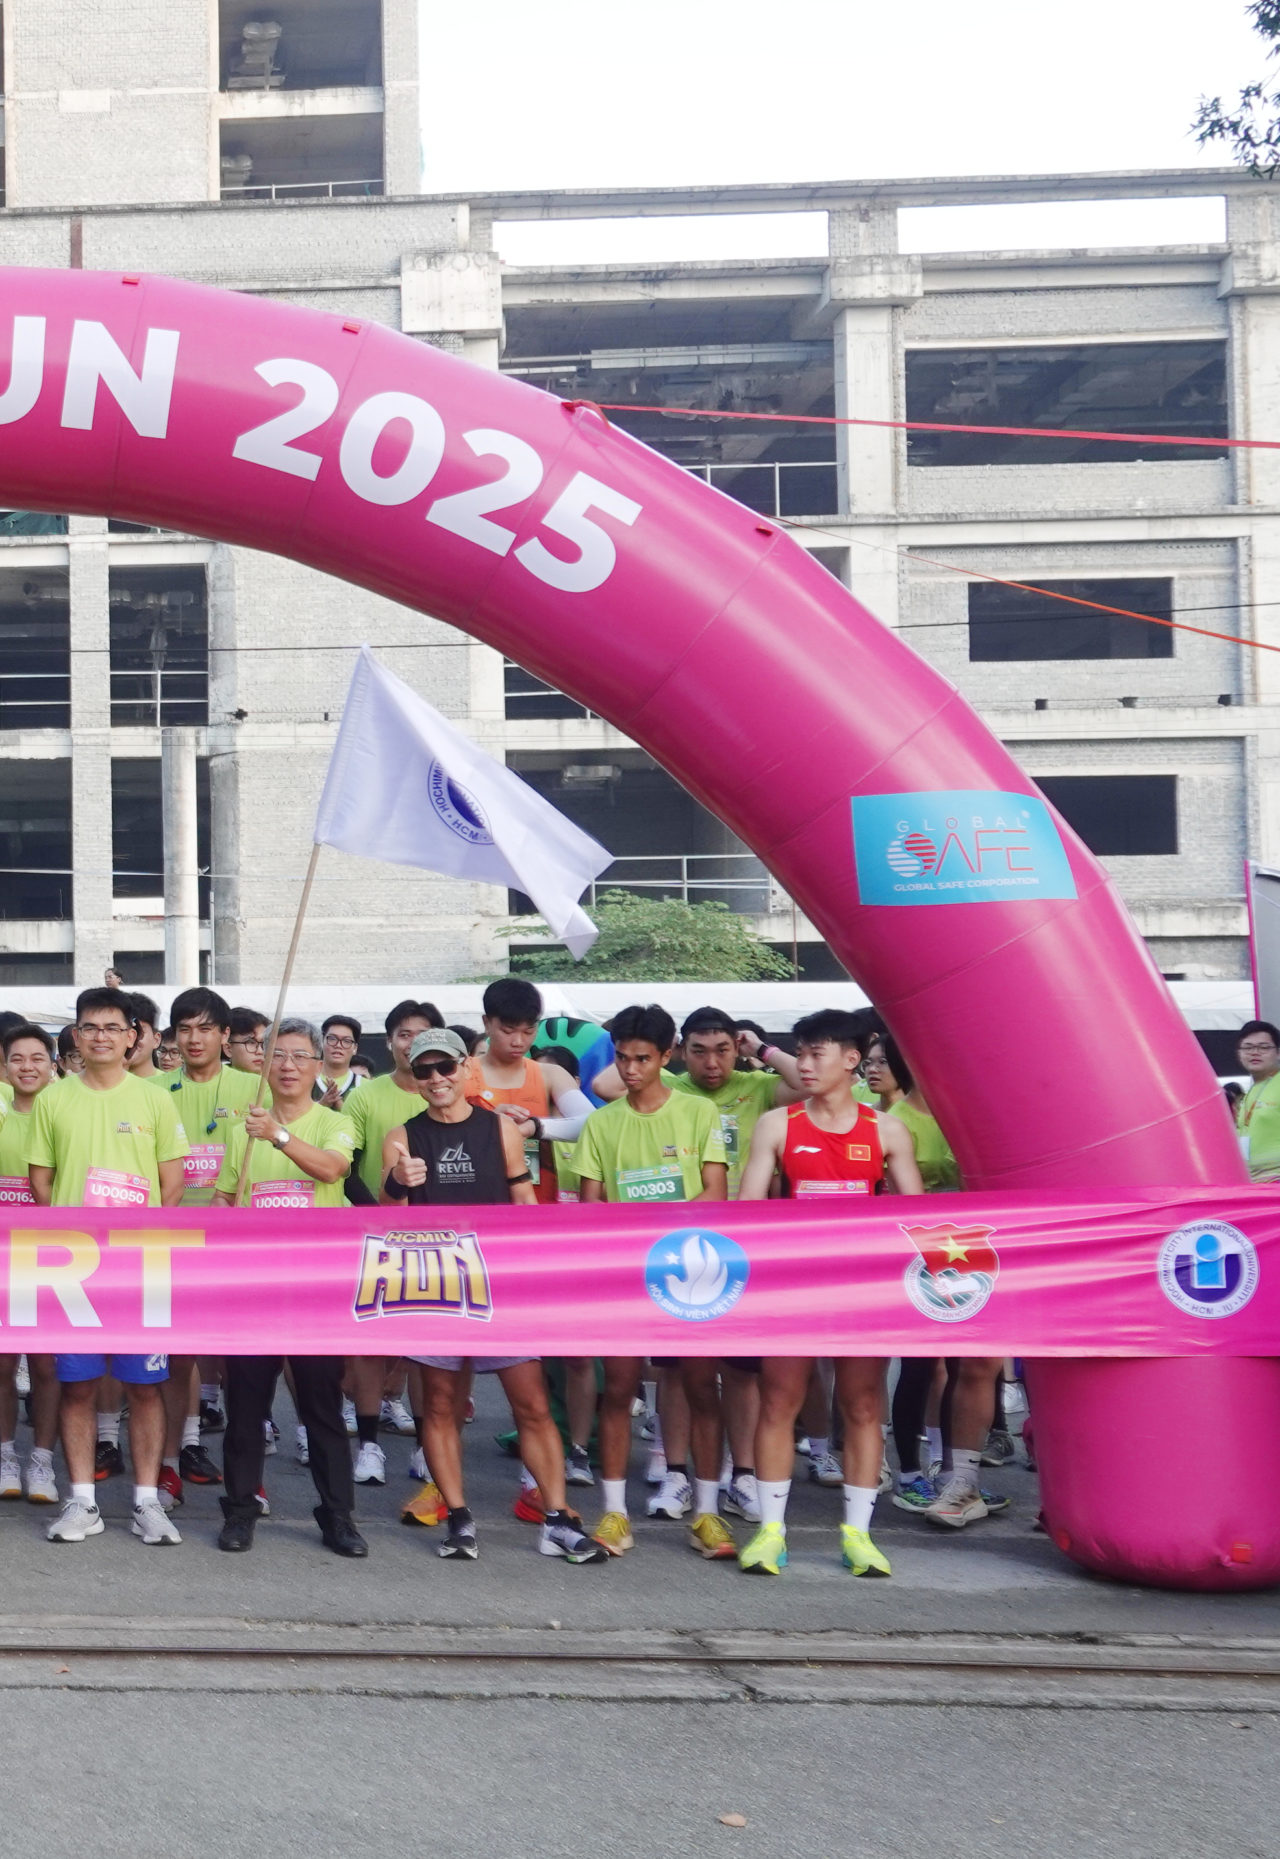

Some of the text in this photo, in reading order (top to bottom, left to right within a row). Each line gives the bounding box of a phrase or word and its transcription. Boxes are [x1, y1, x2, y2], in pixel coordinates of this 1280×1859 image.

[231, 357, 643, 594] 2025
[452, 818, 479, 840] HCM
[896, 815, 1026, 833] GLOBAL
[893, 877, 1039, 892] GLOBAL SAFE CORPORATION
[438, 1162, 476, 1174] REVEL
[91, 1184, 145, 1204] U00050
[386, 1231, 457, 1244] HCMIU
[354, 1233, 492, 1321] RUN
